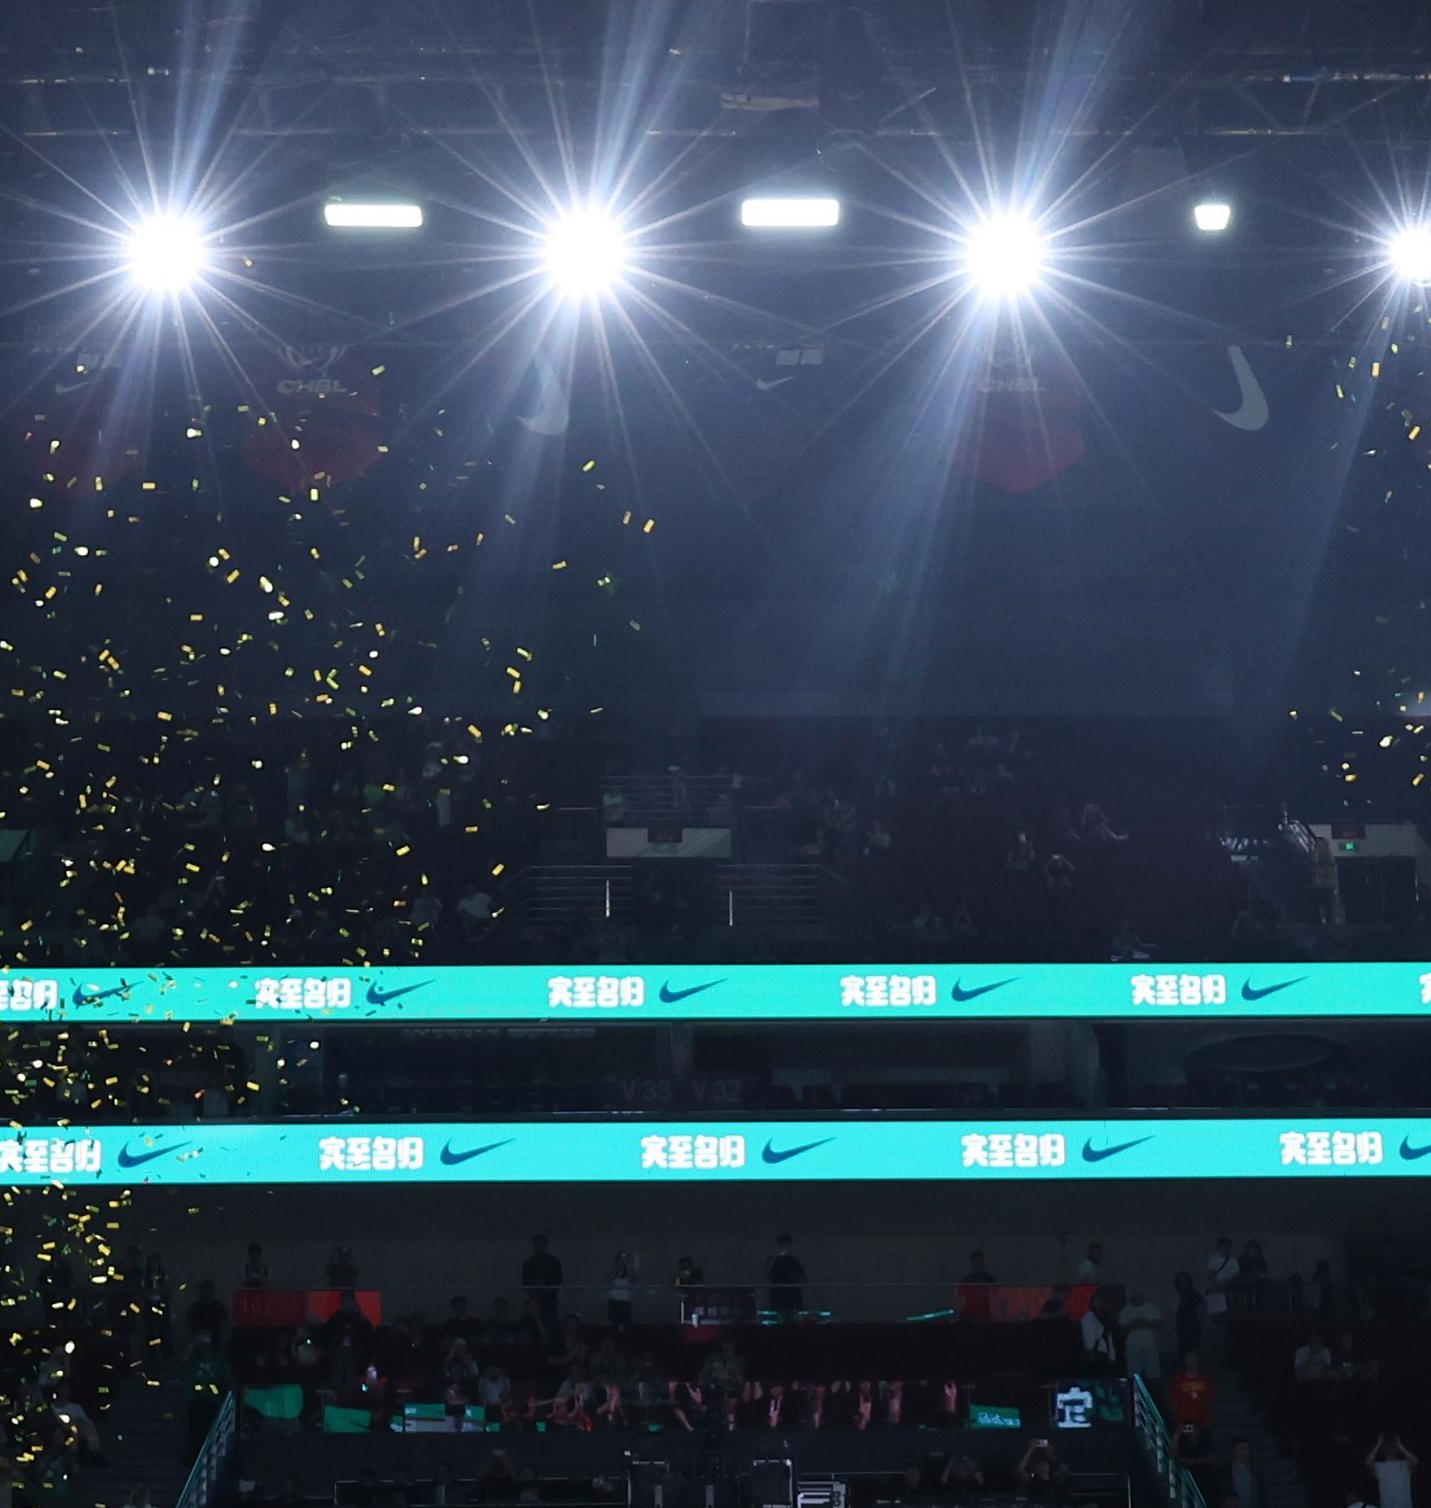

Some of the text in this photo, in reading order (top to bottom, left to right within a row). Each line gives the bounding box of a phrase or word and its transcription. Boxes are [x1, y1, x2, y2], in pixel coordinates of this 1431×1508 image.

[255, 978, 351, 1010] 实至名归
[548, 976, 644, 1007] 实至名归
[841, 975, 936, 1006] 实至名归
[1131, 975, 1226, 1005] 实至名归
[319, 1136, 424, 1170] 实至名归
[641, 1135, 745, 1168] 实至名归
[961, 1133, 1065, 1167] 实至名归
[1280, 1131, 1383, 1164] 实至名归
